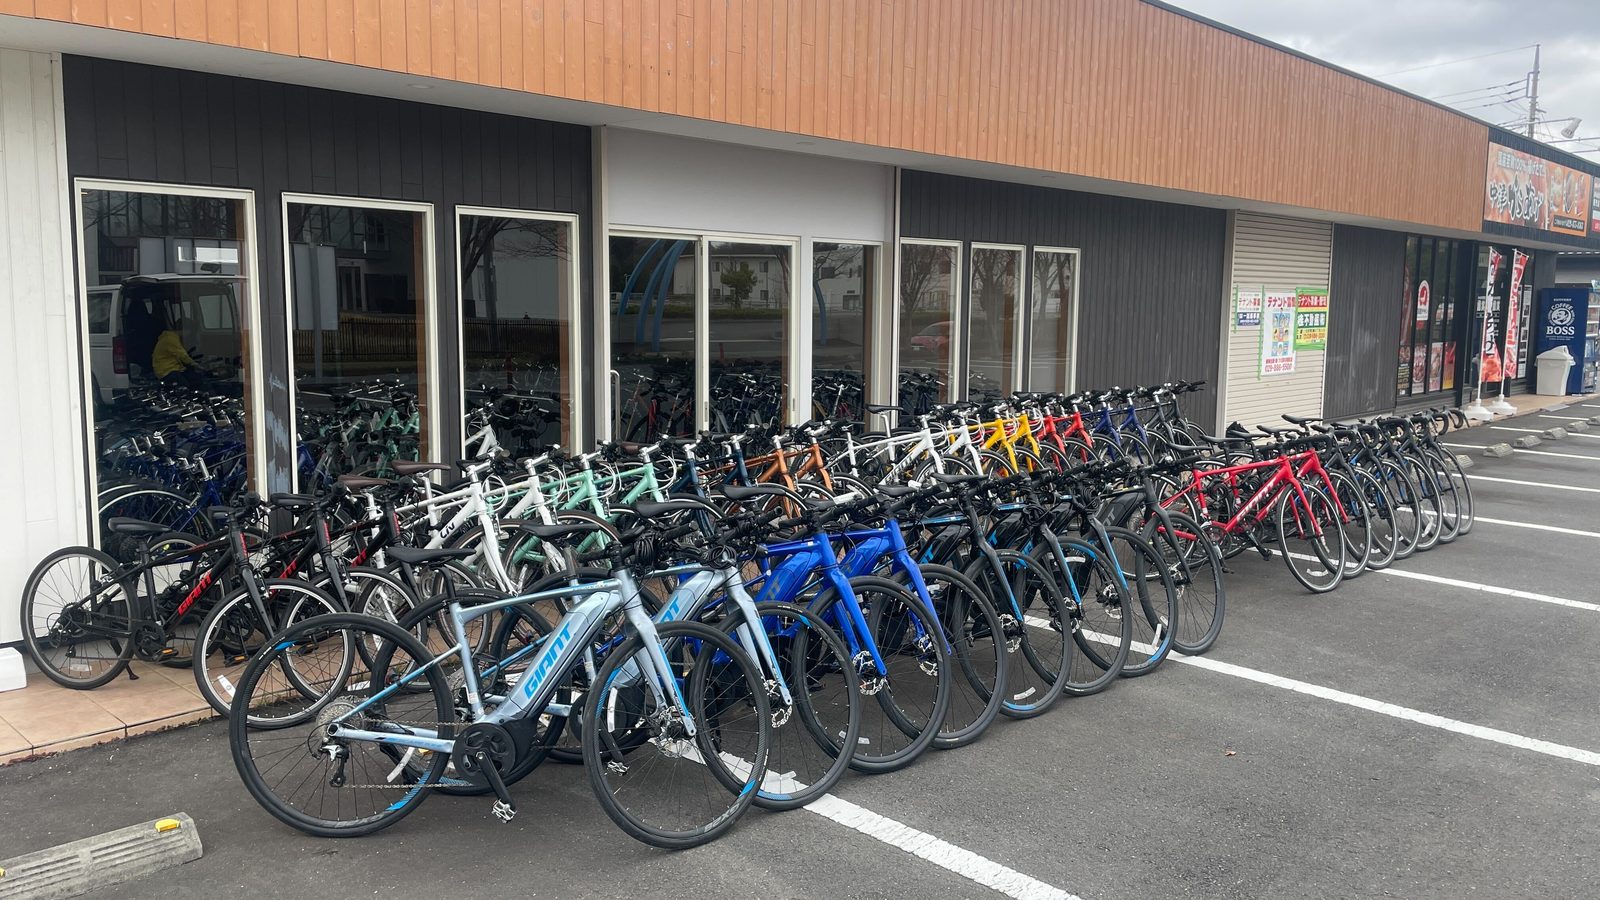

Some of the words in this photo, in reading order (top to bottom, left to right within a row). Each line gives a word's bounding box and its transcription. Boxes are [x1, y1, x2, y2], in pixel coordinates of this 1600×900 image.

[1546, 326, 1575, 336] BOSS
[440, 522, 456, 539] Liv
[178, 572, 212, 615] GIANT
[523, 622, 571, 700] GIANT
